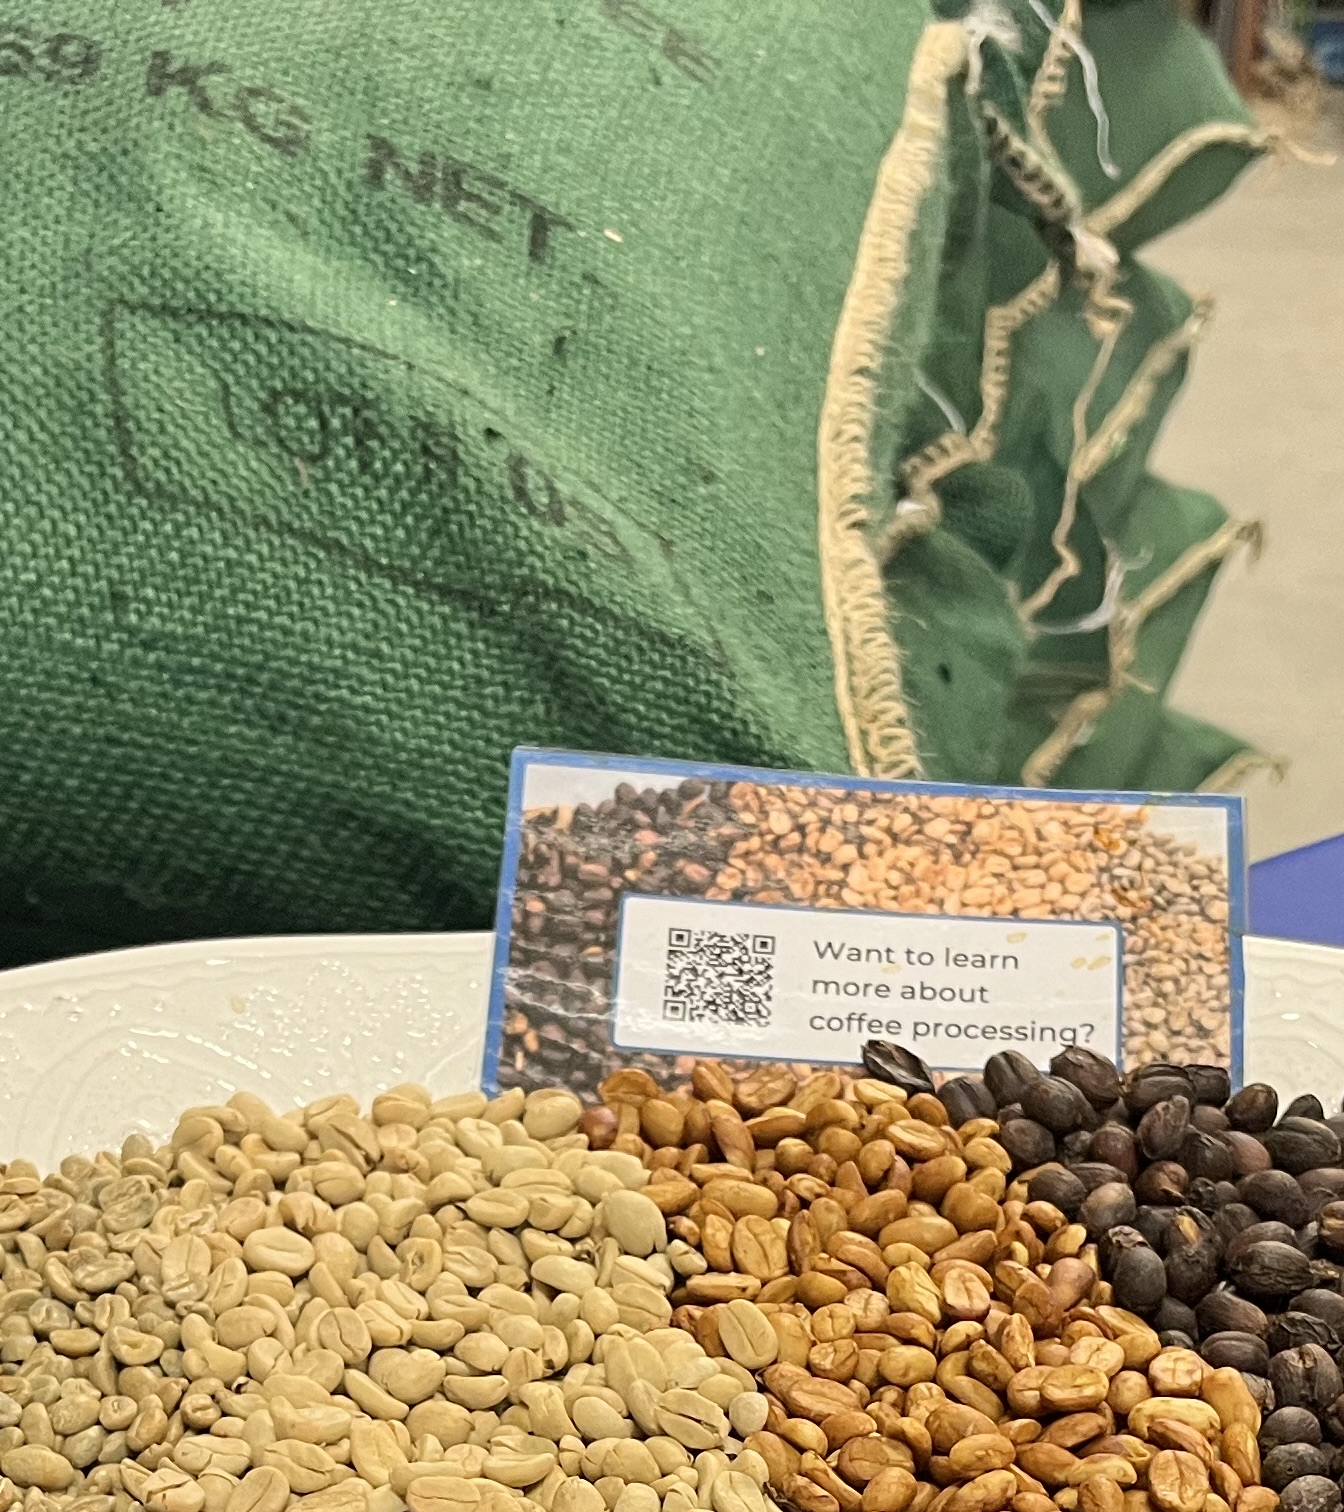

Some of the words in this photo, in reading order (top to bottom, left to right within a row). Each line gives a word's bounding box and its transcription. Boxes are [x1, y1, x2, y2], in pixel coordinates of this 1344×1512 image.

[145, 49, 314, 158] KG
[362, 133, 576, 265] NET
[813, 940, 897, 964] Want
[904, 943, 934, 968] to
[944, 947, 1019, 970] learn
[811, 978, 891, 999] more
[900, 981, 990, 1004] about
[809, 1011, 902, 1036] coffee
[912, 1020, 1095, 1045] processing?
